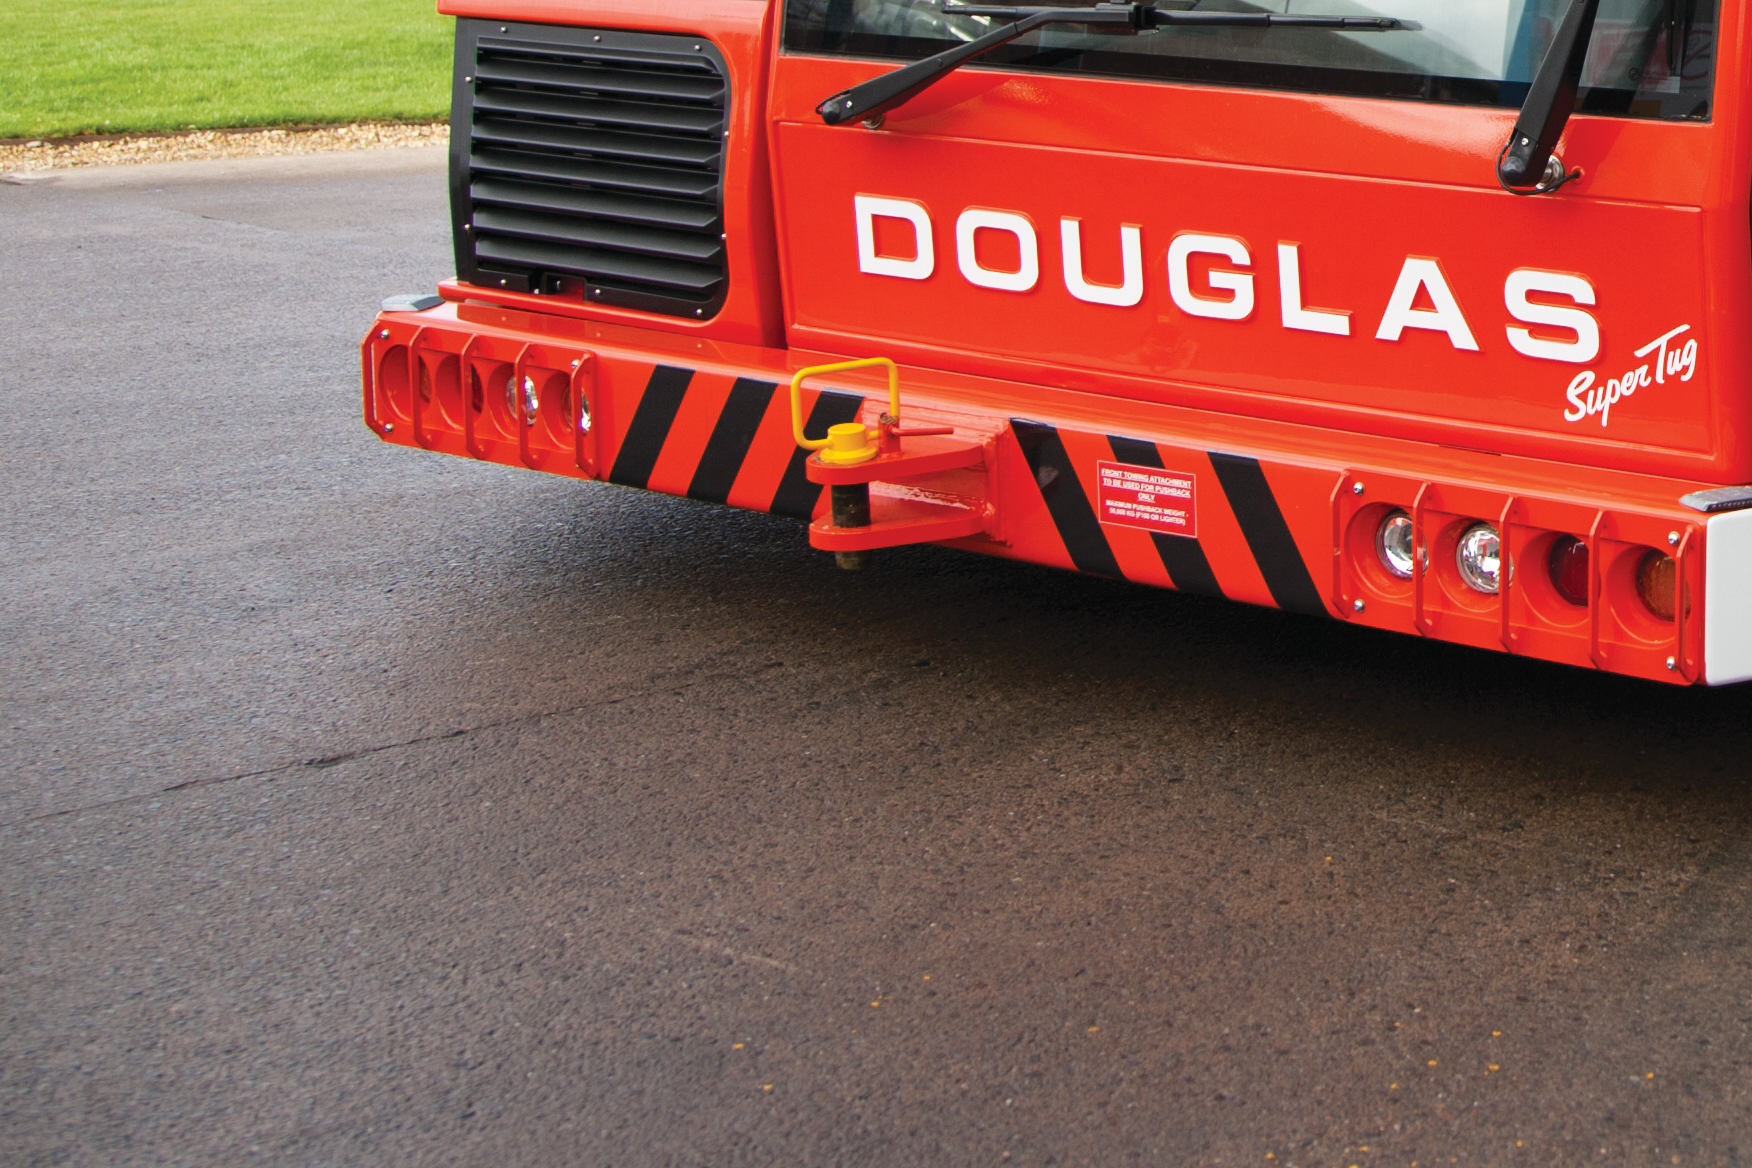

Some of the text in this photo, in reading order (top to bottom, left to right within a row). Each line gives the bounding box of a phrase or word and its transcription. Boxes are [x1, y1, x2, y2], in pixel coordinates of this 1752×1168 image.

[854, 193, 1601, 364] DOUGLAS
[1564, 323, 1698, 427] Super Tug
[1101, 468, 1191, 488] FRONT TOWING ATTACHMENT
[1103, 477, 1112, 486] TO
[1113, 479, 1122, 488] BE
[1123, 481, 1140, 491] USED
[1141, 483, 1154, 493] FOR
